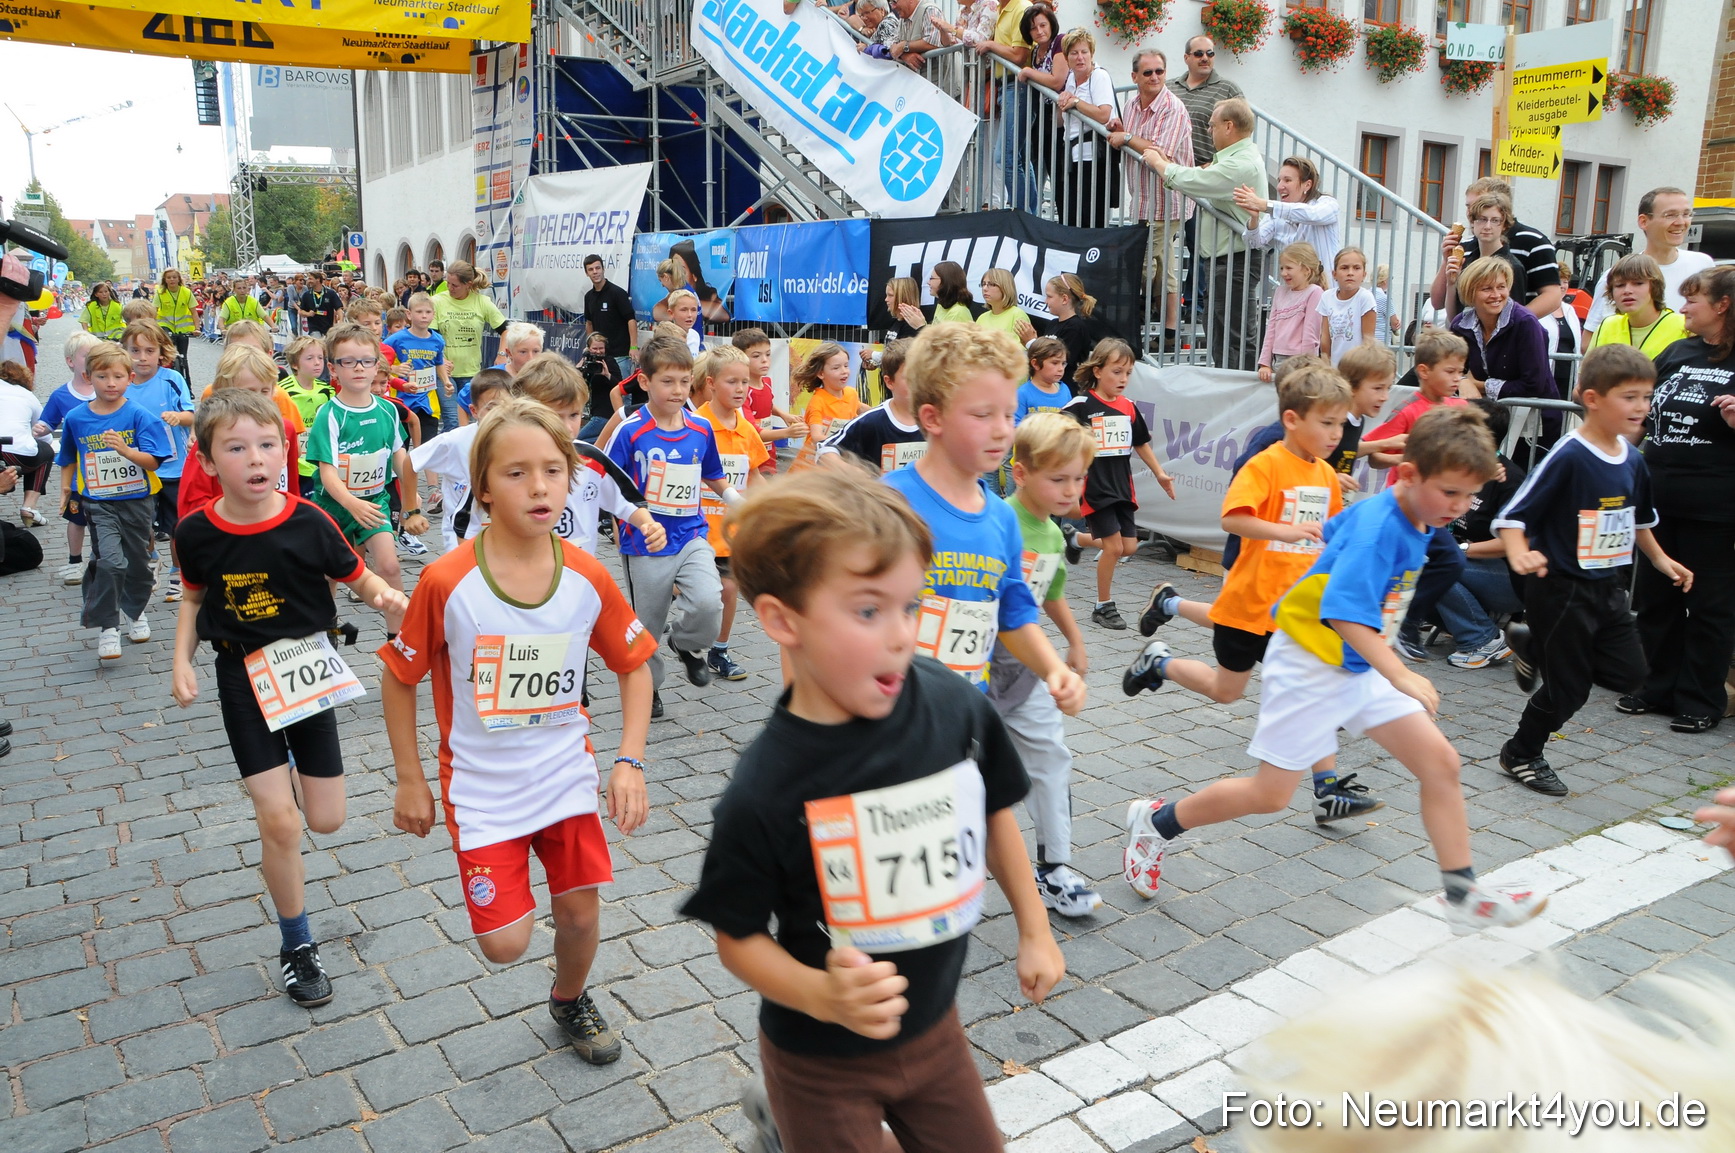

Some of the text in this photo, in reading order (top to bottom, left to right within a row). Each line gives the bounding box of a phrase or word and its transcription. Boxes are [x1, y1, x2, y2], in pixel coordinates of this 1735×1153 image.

[448, 2, 500, 15] Stadtlauf
[341, 37, 451, 51] Neumarkter Stadtlauf
[285, 69, 352, 85] BAROWS
[1516, 94, 1581, 111] Kleiderbeutel-
[1528, 109, 1568, 122] ausgabe
[1509, 144, 1545, 159] Kinder-
[1500, 159, 1549, 179] betreuung
[538, 210, 630, 247] PFLEIDERER
[737, 245, 769, 278] maxi
[758, 279, 773, 303] dsl
[783, 272, 869, 294] maxi-dsl.de
[1017, 293, 1051, 314] SWED
[1678, 365, 1735, 378] Neumarkter
[1687, 374, 1731, 385] STADTLAUF
[338, 436, 365, 453] Sport
[1106, 431, 1129, 442] 7157
[97, 455, 121, 464] Tobias
[100, 465, 138, 480] 7198
[352, 467, 384, 484] 7242
[666, 484, 696, 500] 7291
[222, 573, 269, 581] NEUMARKTER
[227, 578, 264, 587] STADTLAUF
[272, 637, 326, 666] Jonathan
[509, 643, 539, 661] Luis
[281, 656, 344, 693] 7020
[478, 671, 492, 685] K4
[256, 679, 271, 694] K4
[508, 668, 575, 698] 7063
[542, 707, 578, 720] PFLEIDERER
[863, 796, 955, 835] Thomas
[876, 826, 979, 897] 7150
